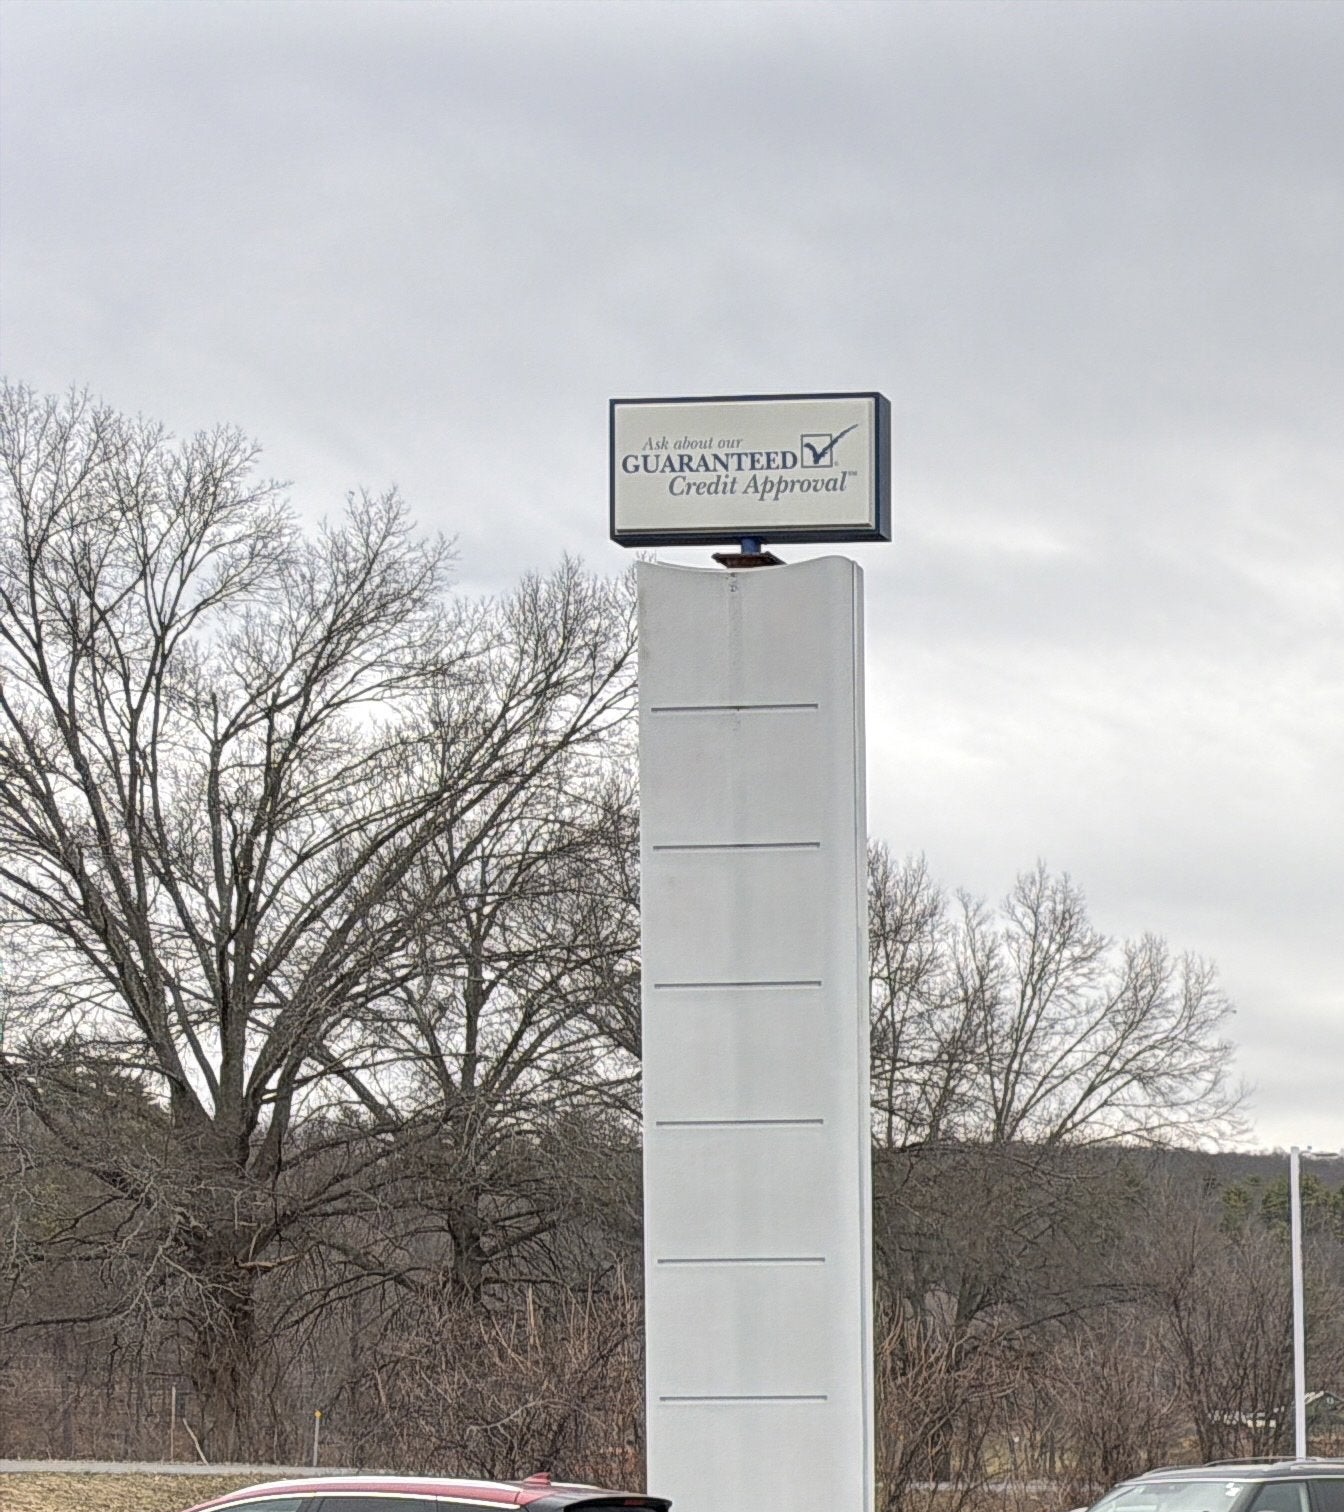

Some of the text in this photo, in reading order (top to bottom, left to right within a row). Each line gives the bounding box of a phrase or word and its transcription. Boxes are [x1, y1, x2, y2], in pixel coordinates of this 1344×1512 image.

[643, 436, 743, 450] Ask about our
[623, 451, 798, 473] GUARANTEED
[668, 474, 737, 496] Credit
